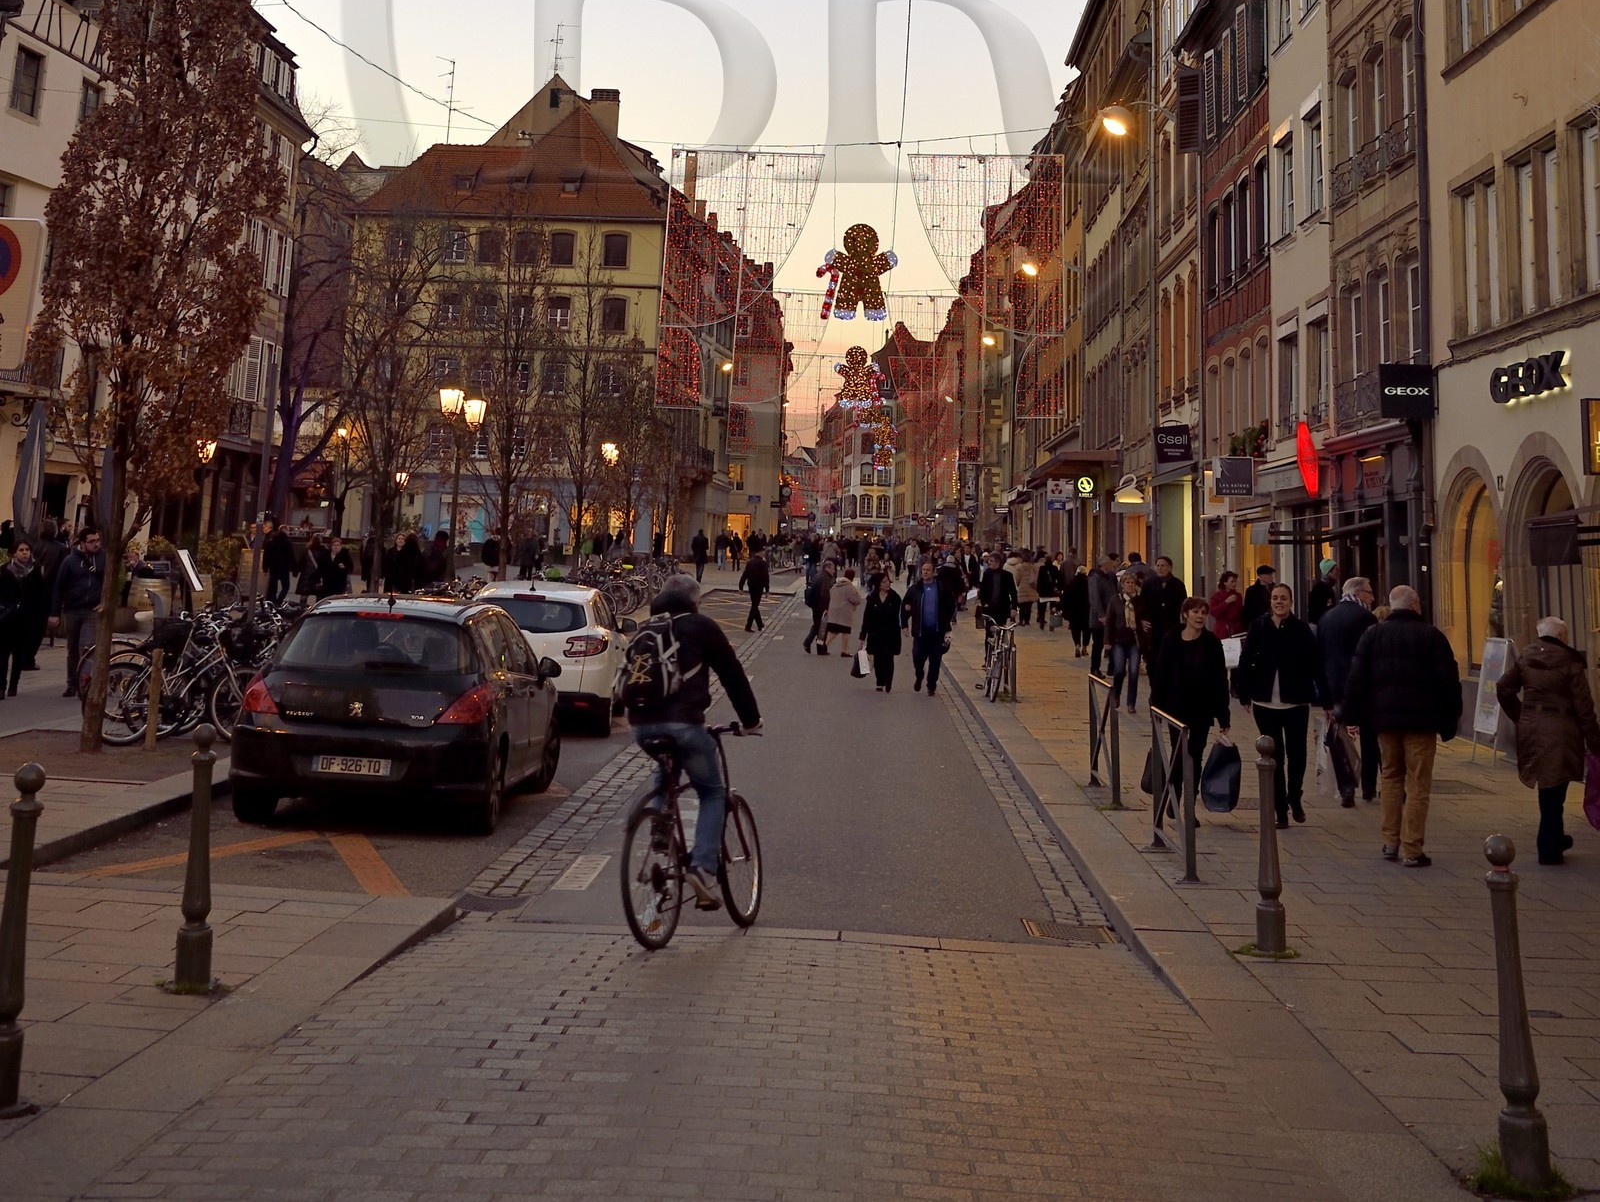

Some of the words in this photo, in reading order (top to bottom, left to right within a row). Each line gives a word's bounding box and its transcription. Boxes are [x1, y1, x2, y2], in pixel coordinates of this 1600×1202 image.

[1489, 350, 1567, 404] GEOX
[1384, 386, 1430, 396] GEOX
[1157, 433, 1188, 445] Gsell
[285, 709, 315, 717] PEUGEOT
